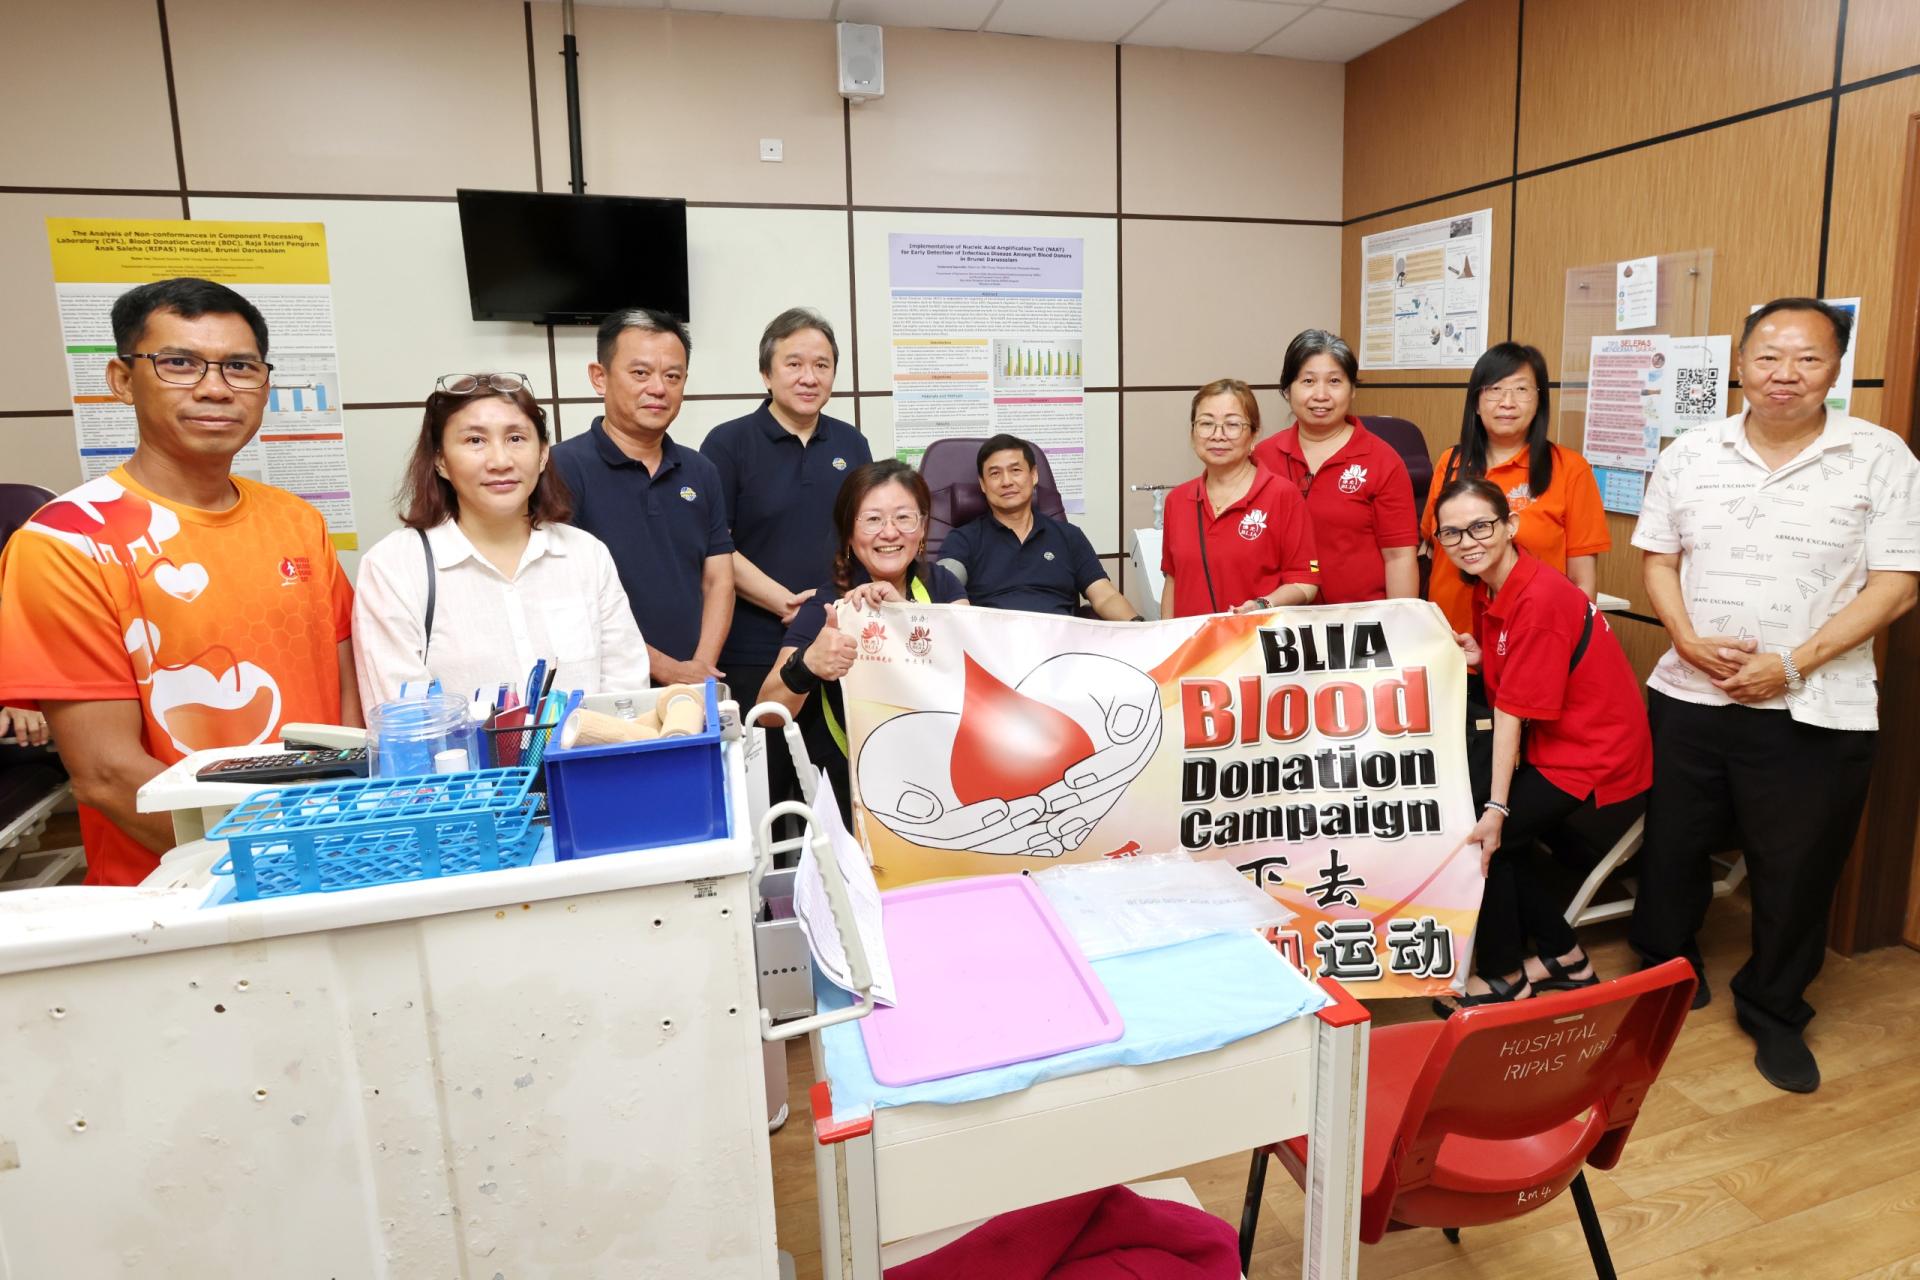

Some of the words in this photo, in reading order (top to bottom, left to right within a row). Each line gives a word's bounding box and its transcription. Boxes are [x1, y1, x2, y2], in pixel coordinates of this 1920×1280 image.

[134, 231, 207, 239] Non-conformances
[263, 233, 303, 241] Processing
[245, 240, 261, 248] Raja
[1620, 339, 1652, 348] SELEPAS
[1775, 534, 1804, 543] ARMANI
[1806, 537, 1845, 549] EXCHANGE
[1710, 598, 1745, 607] EXCHANGE
[1258, 620, 1395, 675] BLIA
[1180, 665, 1433, 751] Blood
[1181, 744, 1437, 804] Donation
[1180, 795, 1442, 851] Campaign
[1499, 1022, 1598, 1057] HOSPITAL
[1503, 1053, 1567, 1081] RIPAS
